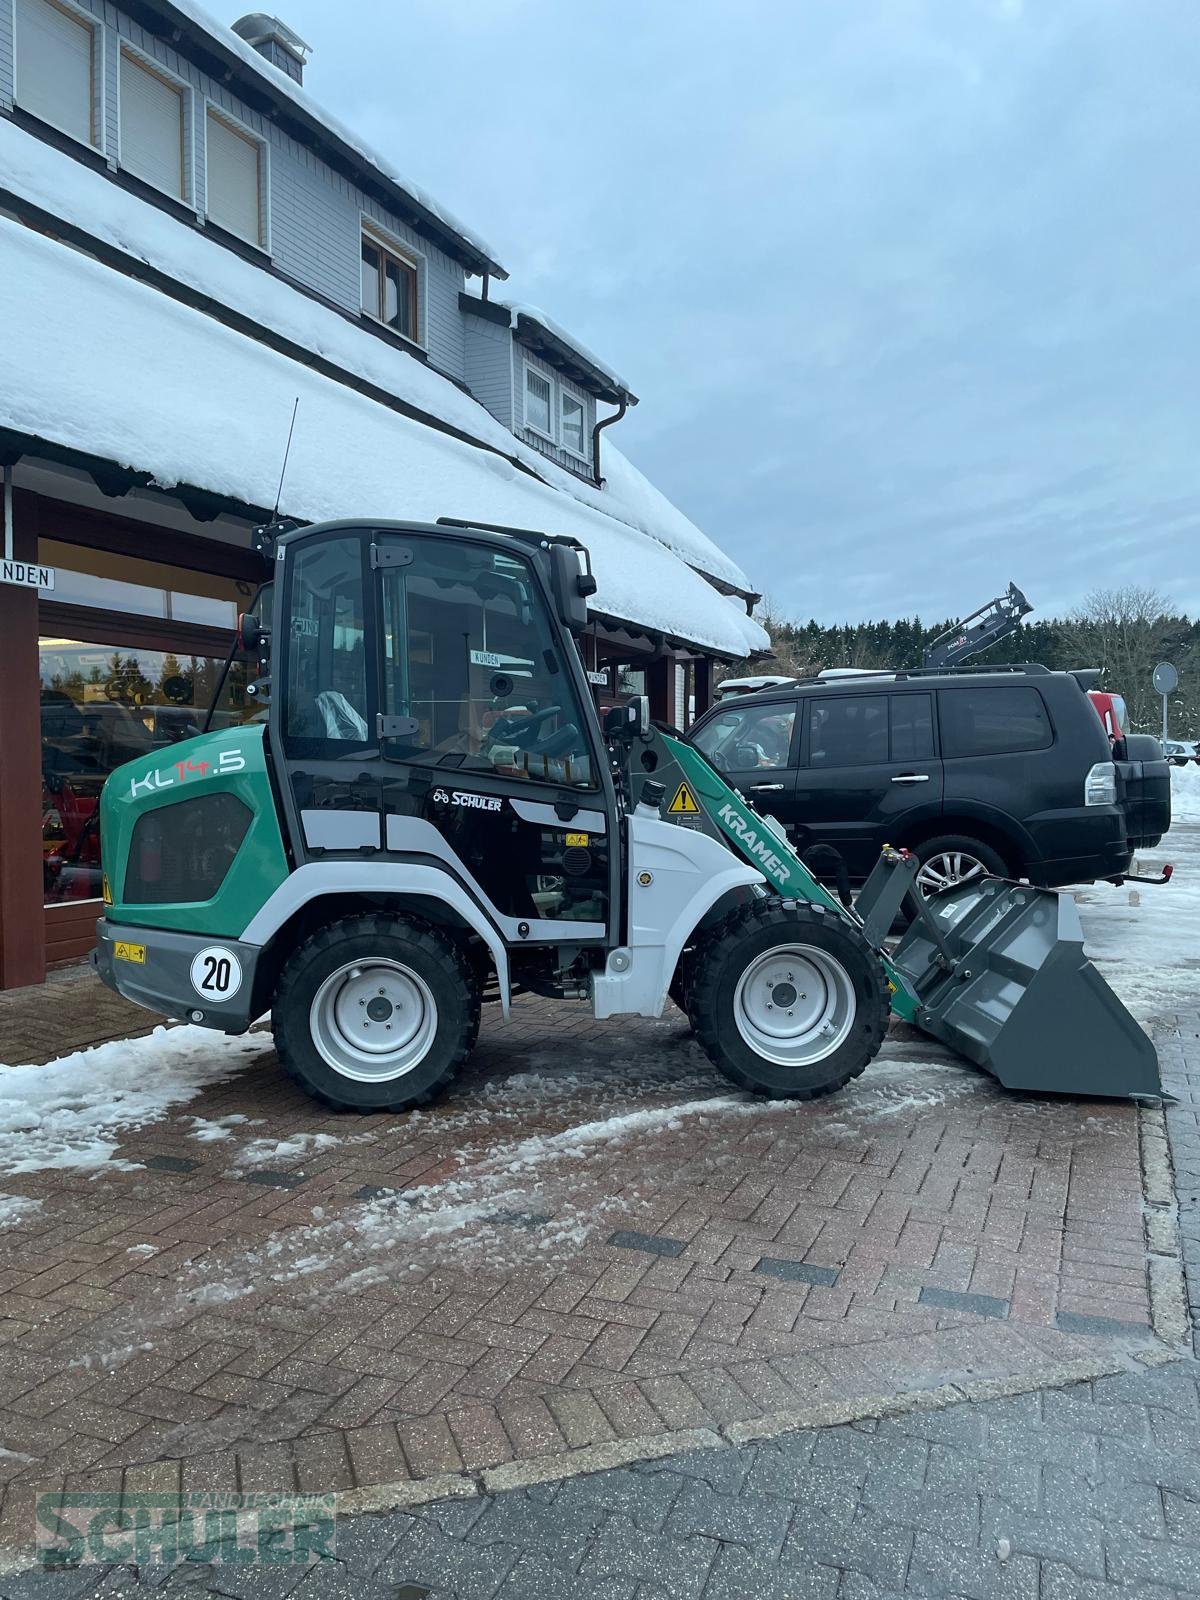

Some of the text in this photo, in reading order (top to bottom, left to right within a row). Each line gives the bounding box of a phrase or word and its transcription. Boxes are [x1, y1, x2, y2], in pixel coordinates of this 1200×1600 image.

[3, 562, 48, 586] NDEN
[474, 652, 499, 666] KUNDEN
[451, 791, 502, 812] SCHULER
[717, 803, 791, 885] KRAMER
[201, 955, 231, 992] 20
